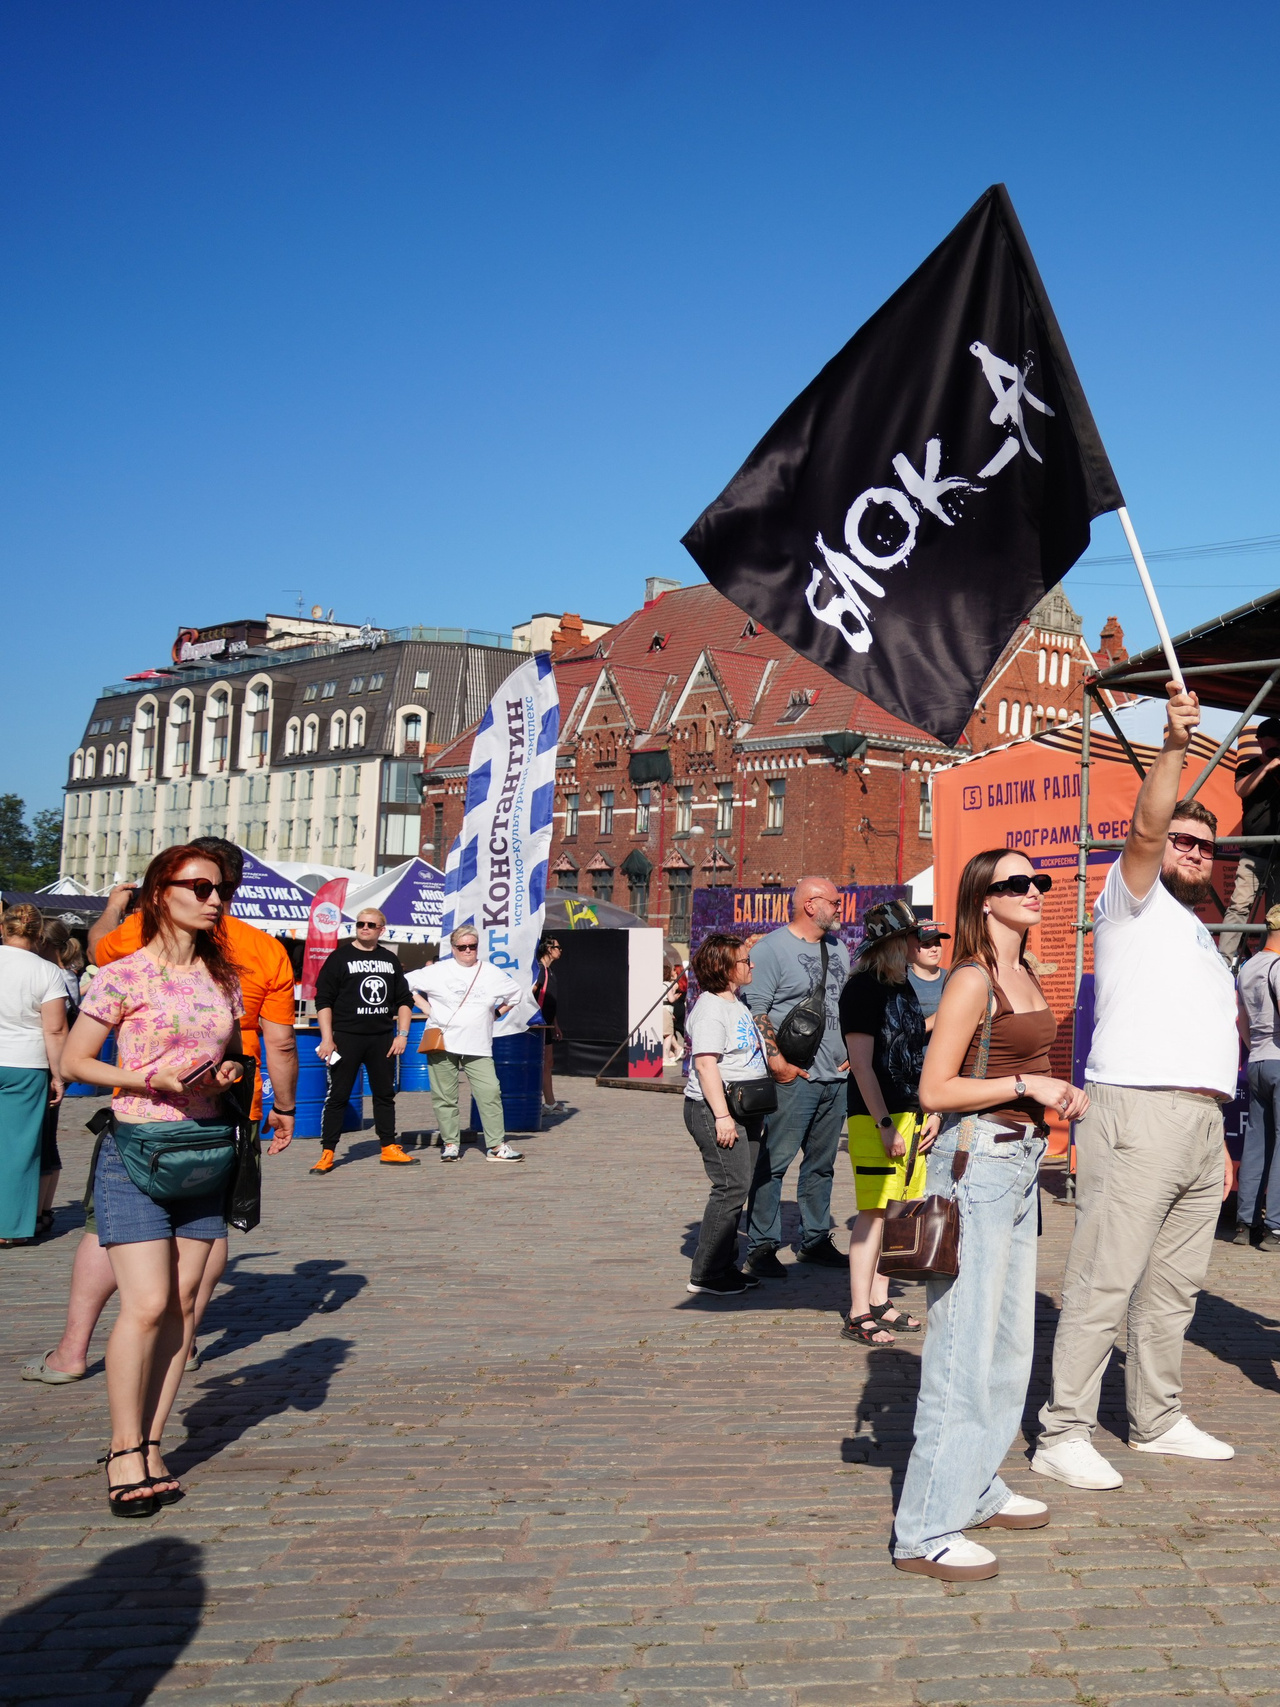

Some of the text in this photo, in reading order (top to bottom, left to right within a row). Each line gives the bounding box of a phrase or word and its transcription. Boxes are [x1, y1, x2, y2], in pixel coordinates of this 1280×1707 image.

[988, 779, 1036, 808] БАЛТИК
[1044, 773, 1089, 801] РАЛЛ
[1098, 818, 1133, 839] ФЕС
[1041, 856, 1077, 867] ВОСКРЕСЕНЬЕ
[236, 885, 304, 901] ИБУТИКА
[418, 889, 445, 901] ИНФ
[267, 904, 311, 919] РАЛЛ
[411, 900, 443, 913] ЭКСКУ
[733, 893, 790, 923] БАЛТИК
[410, 912, 443, 925] РЕГИС
[347, 960, 395, 975] MOSCHINO
[357, 1006, 389, 1015] MILANO
[737, 1012, 750, 1050] SANT
